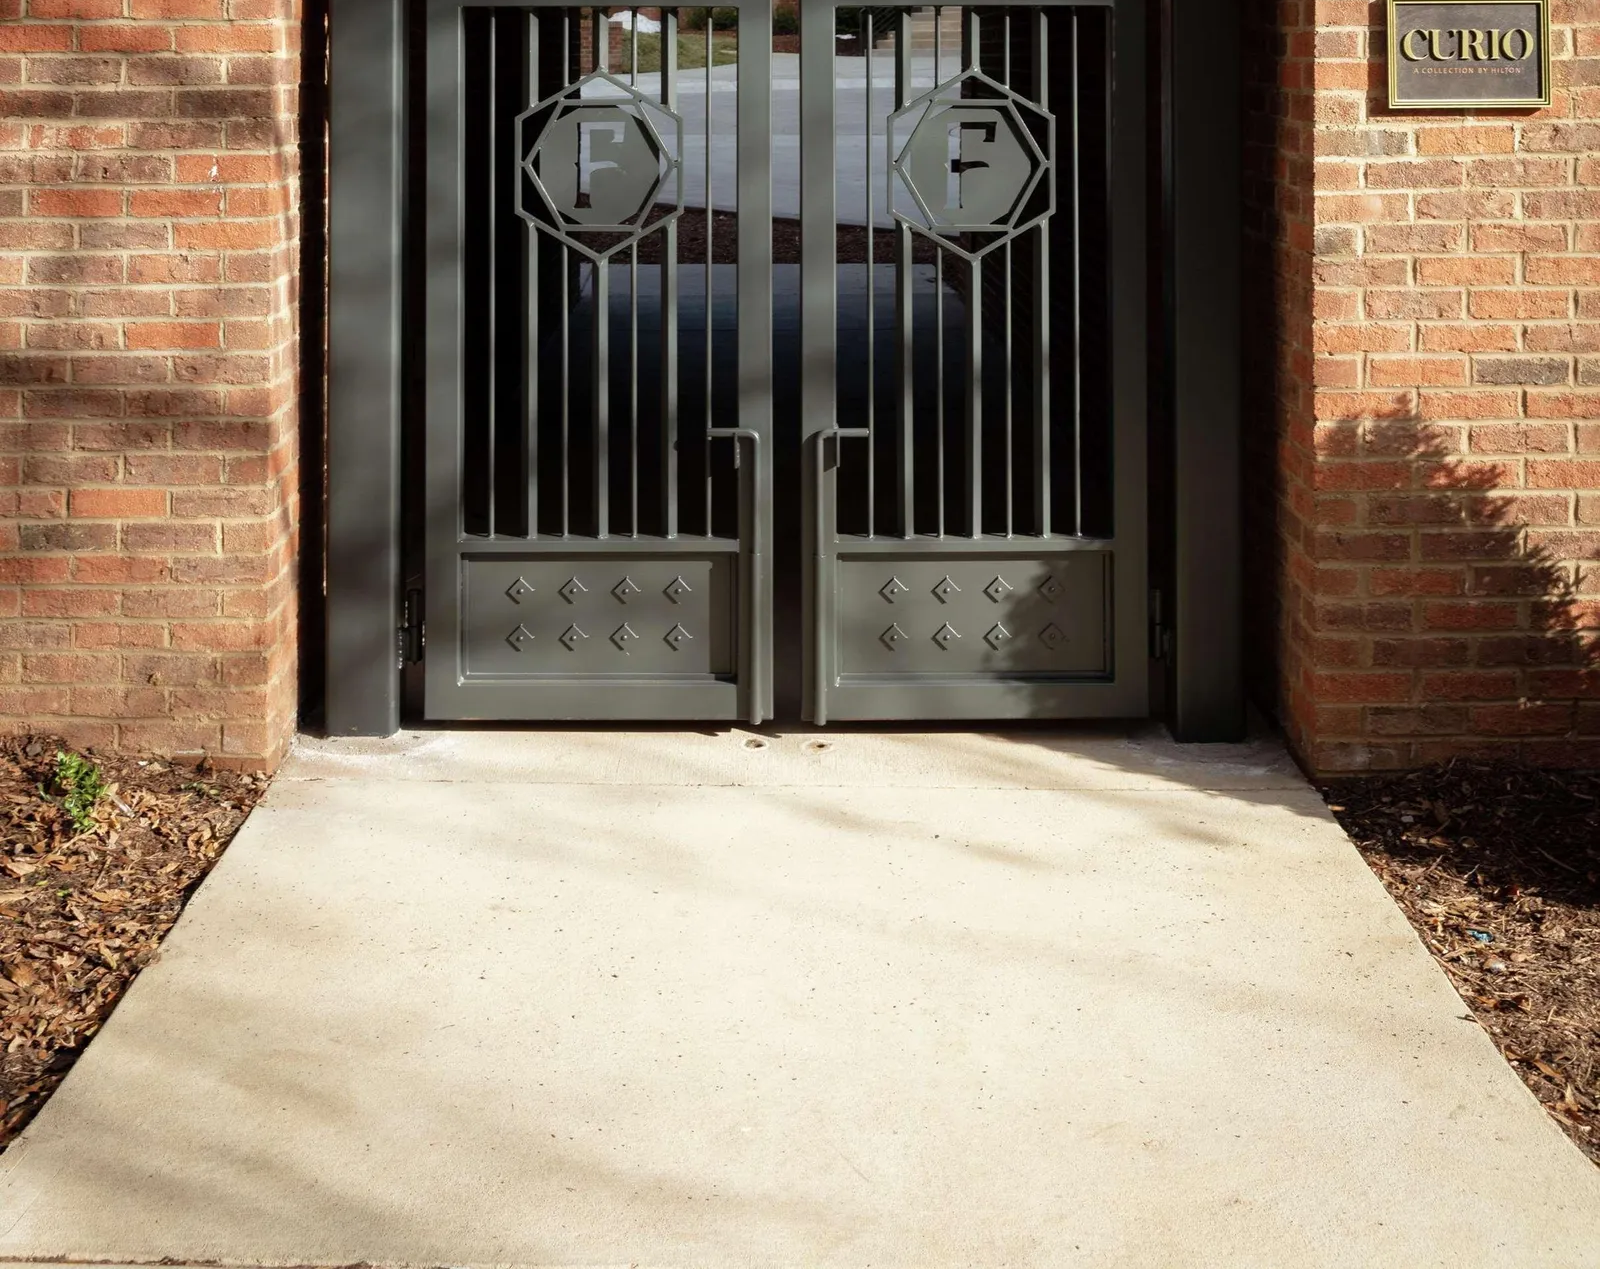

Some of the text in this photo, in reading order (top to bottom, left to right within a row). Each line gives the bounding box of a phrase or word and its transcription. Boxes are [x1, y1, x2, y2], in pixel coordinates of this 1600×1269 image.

[1402, 28, 1534, 61] CURIO
[573, 121, 626, 209] F
[944, 121, 997, 209] F
